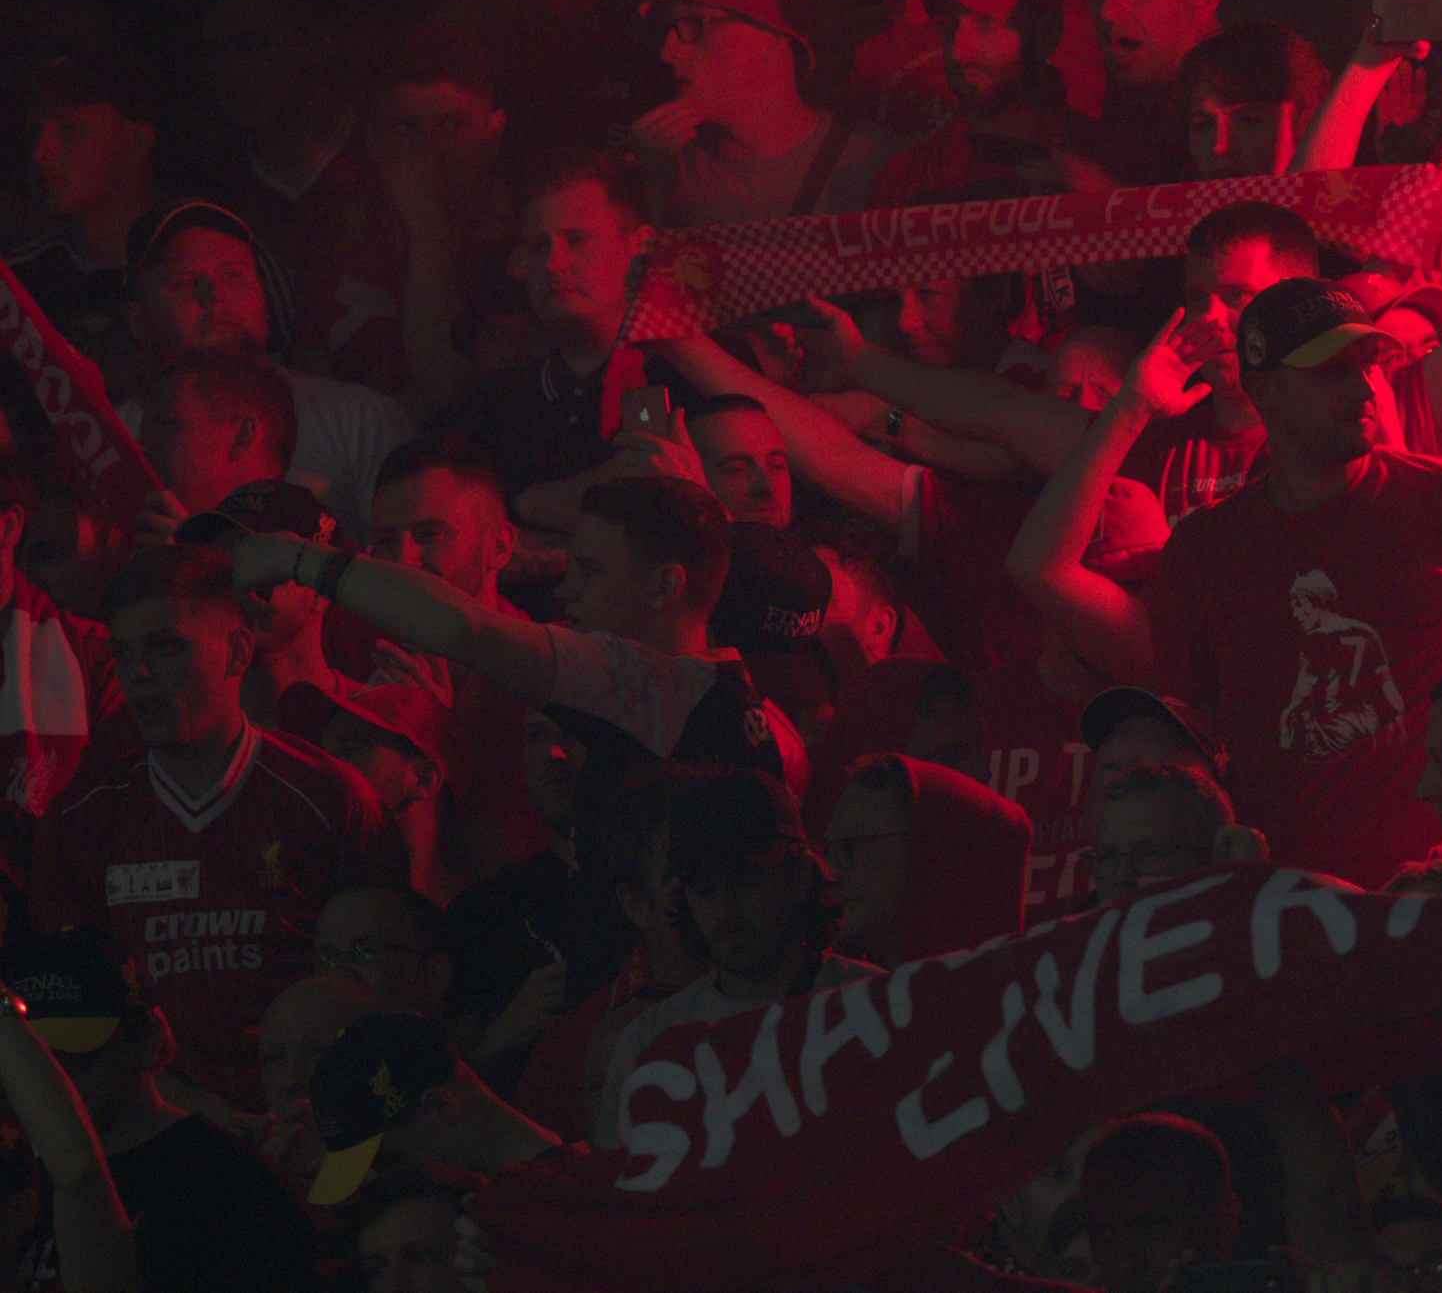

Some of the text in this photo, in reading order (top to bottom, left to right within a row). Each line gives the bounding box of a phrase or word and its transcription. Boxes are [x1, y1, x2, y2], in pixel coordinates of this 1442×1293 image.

[832, 194, 1074, 256] LIVERPOOL
[1339, 635, 1366, 688] 7
[144, 909, 267, 941] crown
[148, 940, 262, 979] paints
